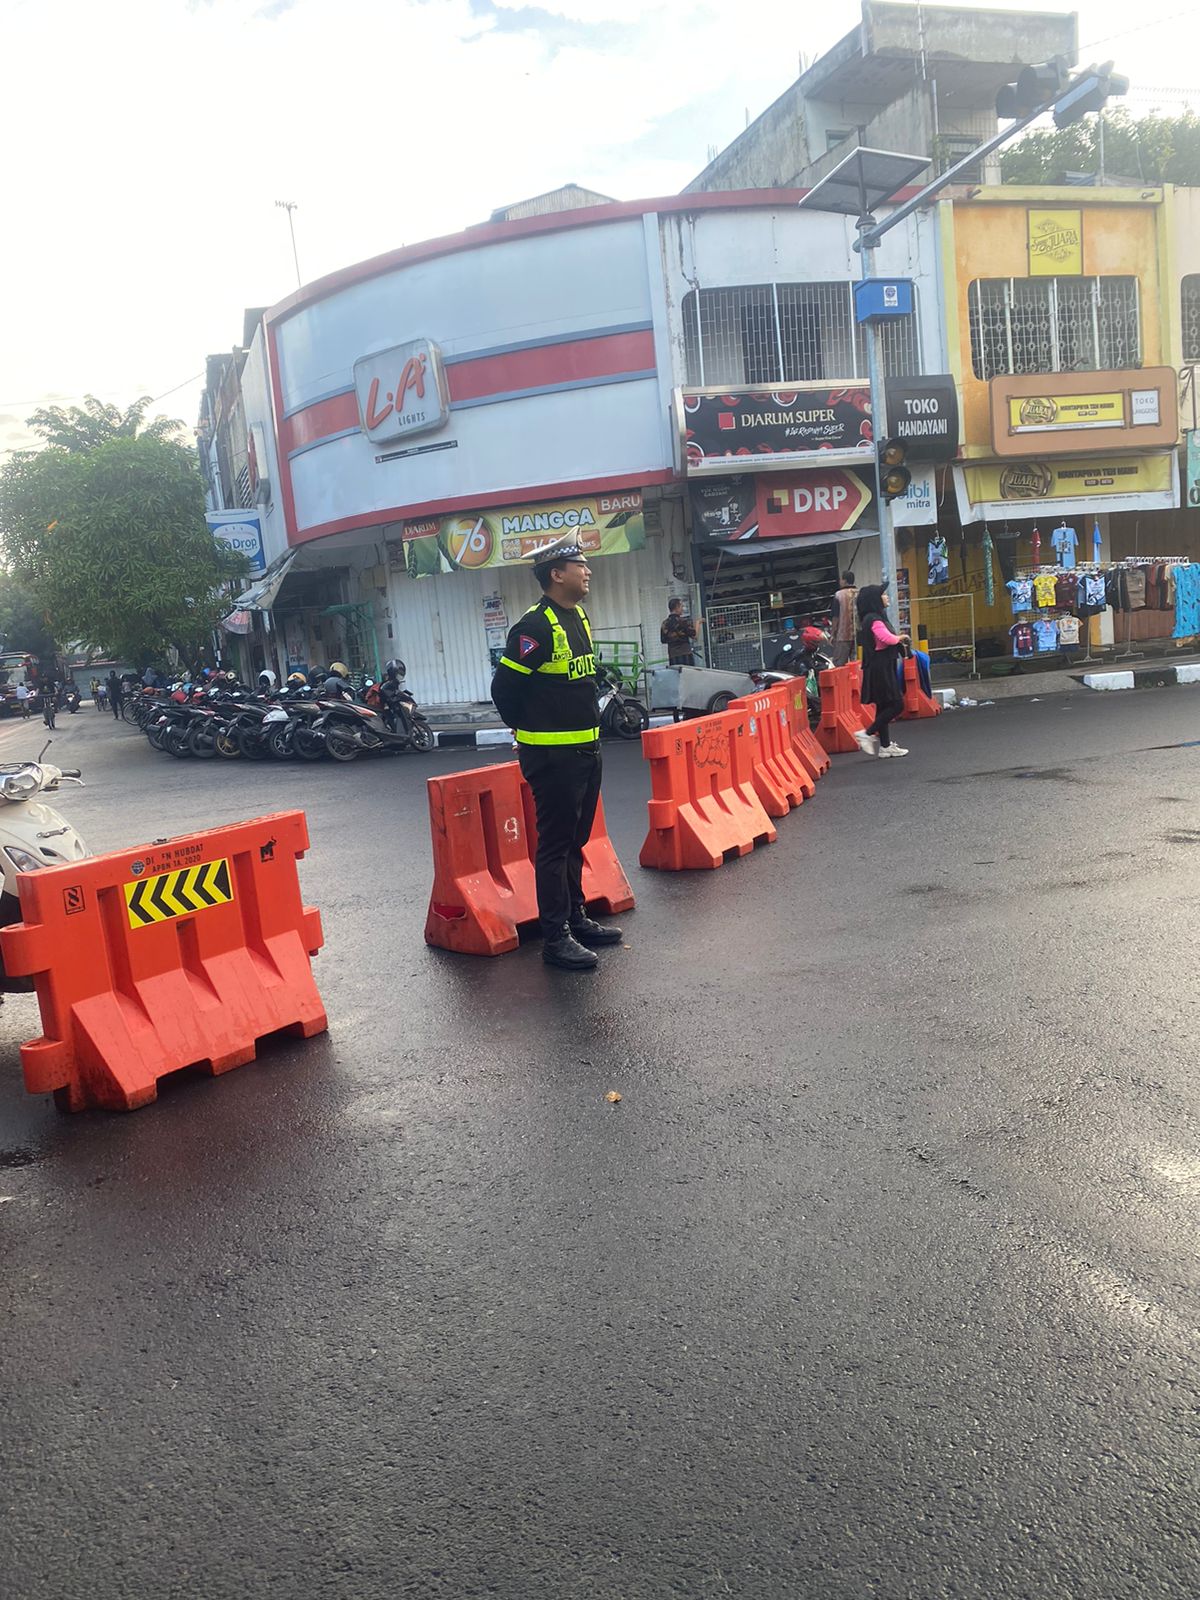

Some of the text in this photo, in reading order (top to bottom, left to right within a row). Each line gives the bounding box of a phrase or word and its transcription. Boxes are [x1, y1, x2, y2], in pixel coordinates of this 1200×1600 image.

[904, 398, 939, 414] TOKO
[398, 412, 426, 426] LIGHTS
[741, 408, 836, 428] DJARUM SUPER
[898, 418, 948, 437] HANDAYANI
[601, 496, 641, 511] BARU
[793, 486, 848, 513] DRP
[906, 499, 930, 509] mitra
[404, 522, 437, 537] DJARUM
[502, 508, 595, 534] MANGGA
[455, 517, 486, 563] 76
[174, 843, 204, 858] HUBDAT
[152, 862, 171, 873] APBN
[185, 854, 202, 865] 2020
